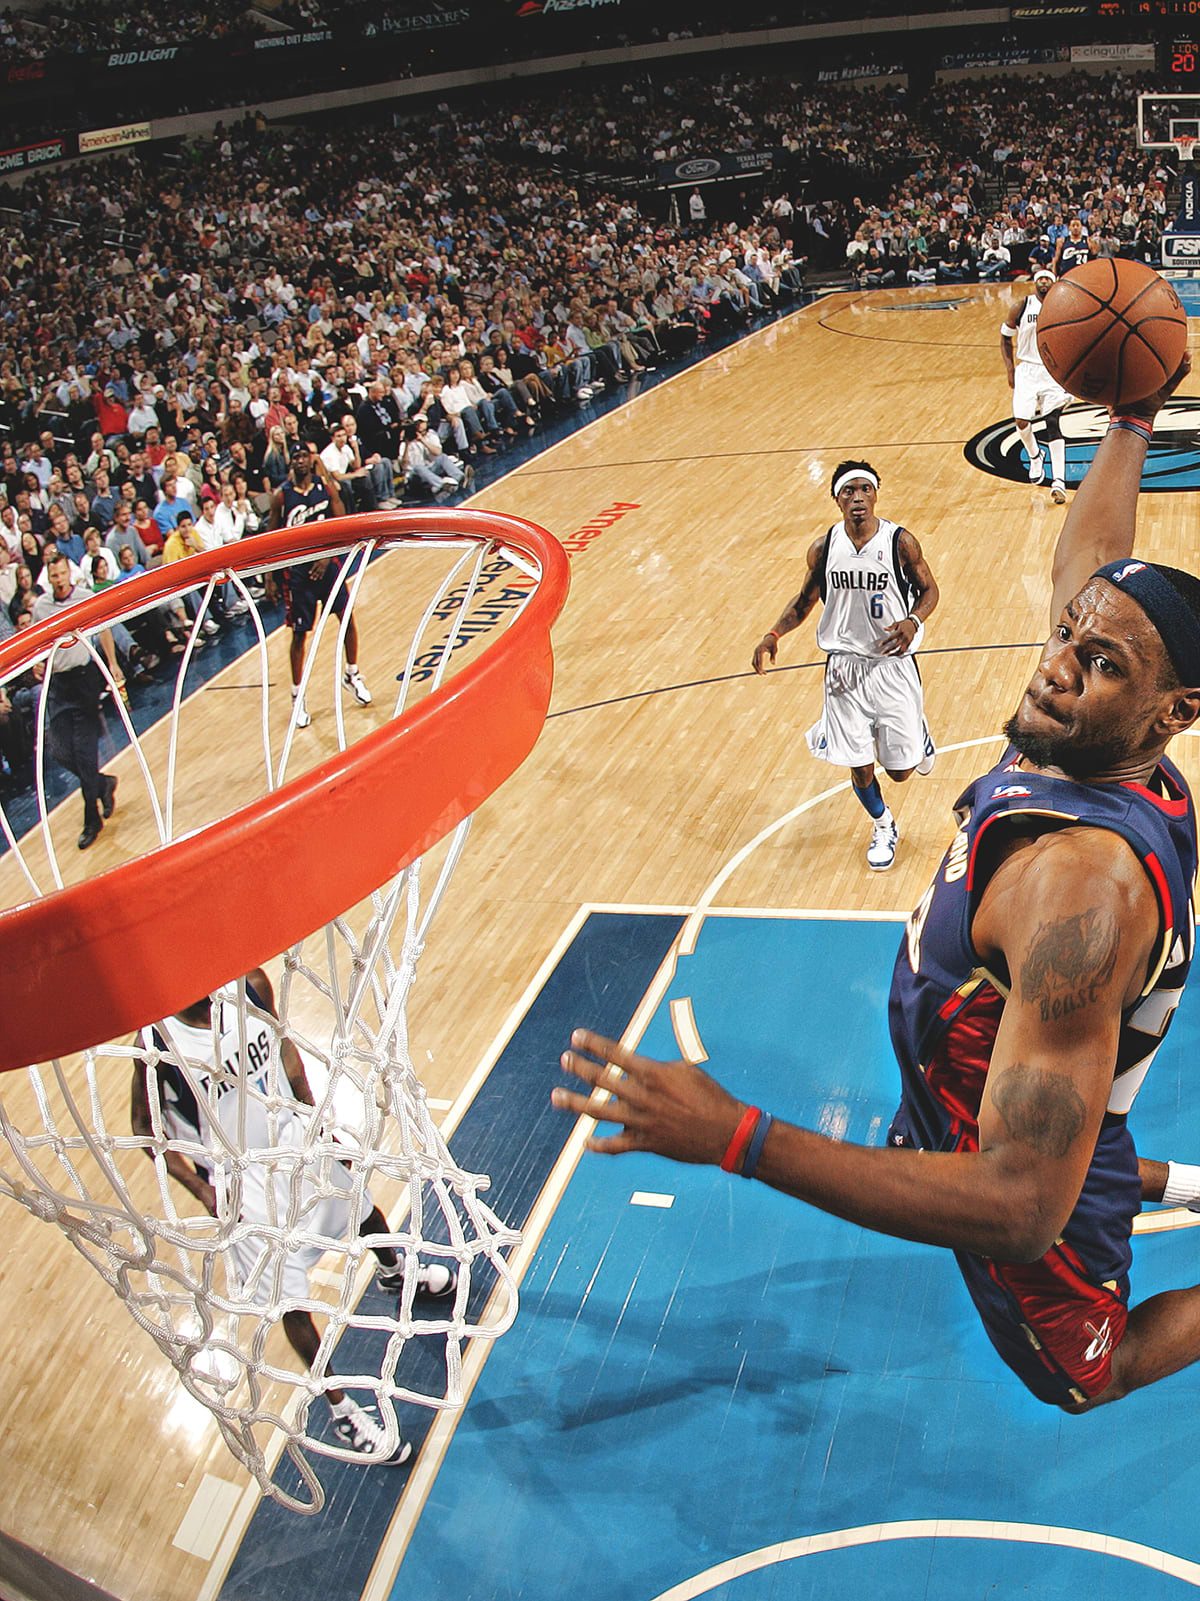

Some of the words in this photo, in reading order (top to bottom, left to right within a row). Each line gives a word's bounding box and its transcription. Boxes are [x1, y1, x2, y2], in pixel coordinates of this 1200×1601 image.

[1013, 8, 1045, 17] BUD
[1050, 6, 1088, 16] LIGHT
[254, 35, 286, 50] NOTHING
[302, 31, 326, 43] ABOUT
[107, 52, 138, 67] BUD
[138, 48, 179, 62] LIGHT
[1083, 46, 1131, 56] cingular
[1171, 53, 1195, 73] 20
[27, 143, 63, 164] BRICK
[1185, 180, 1194, 220] NOKIA
[831, 570, 889, 591] DALLAS
[870, 594, 884, 619] 6
